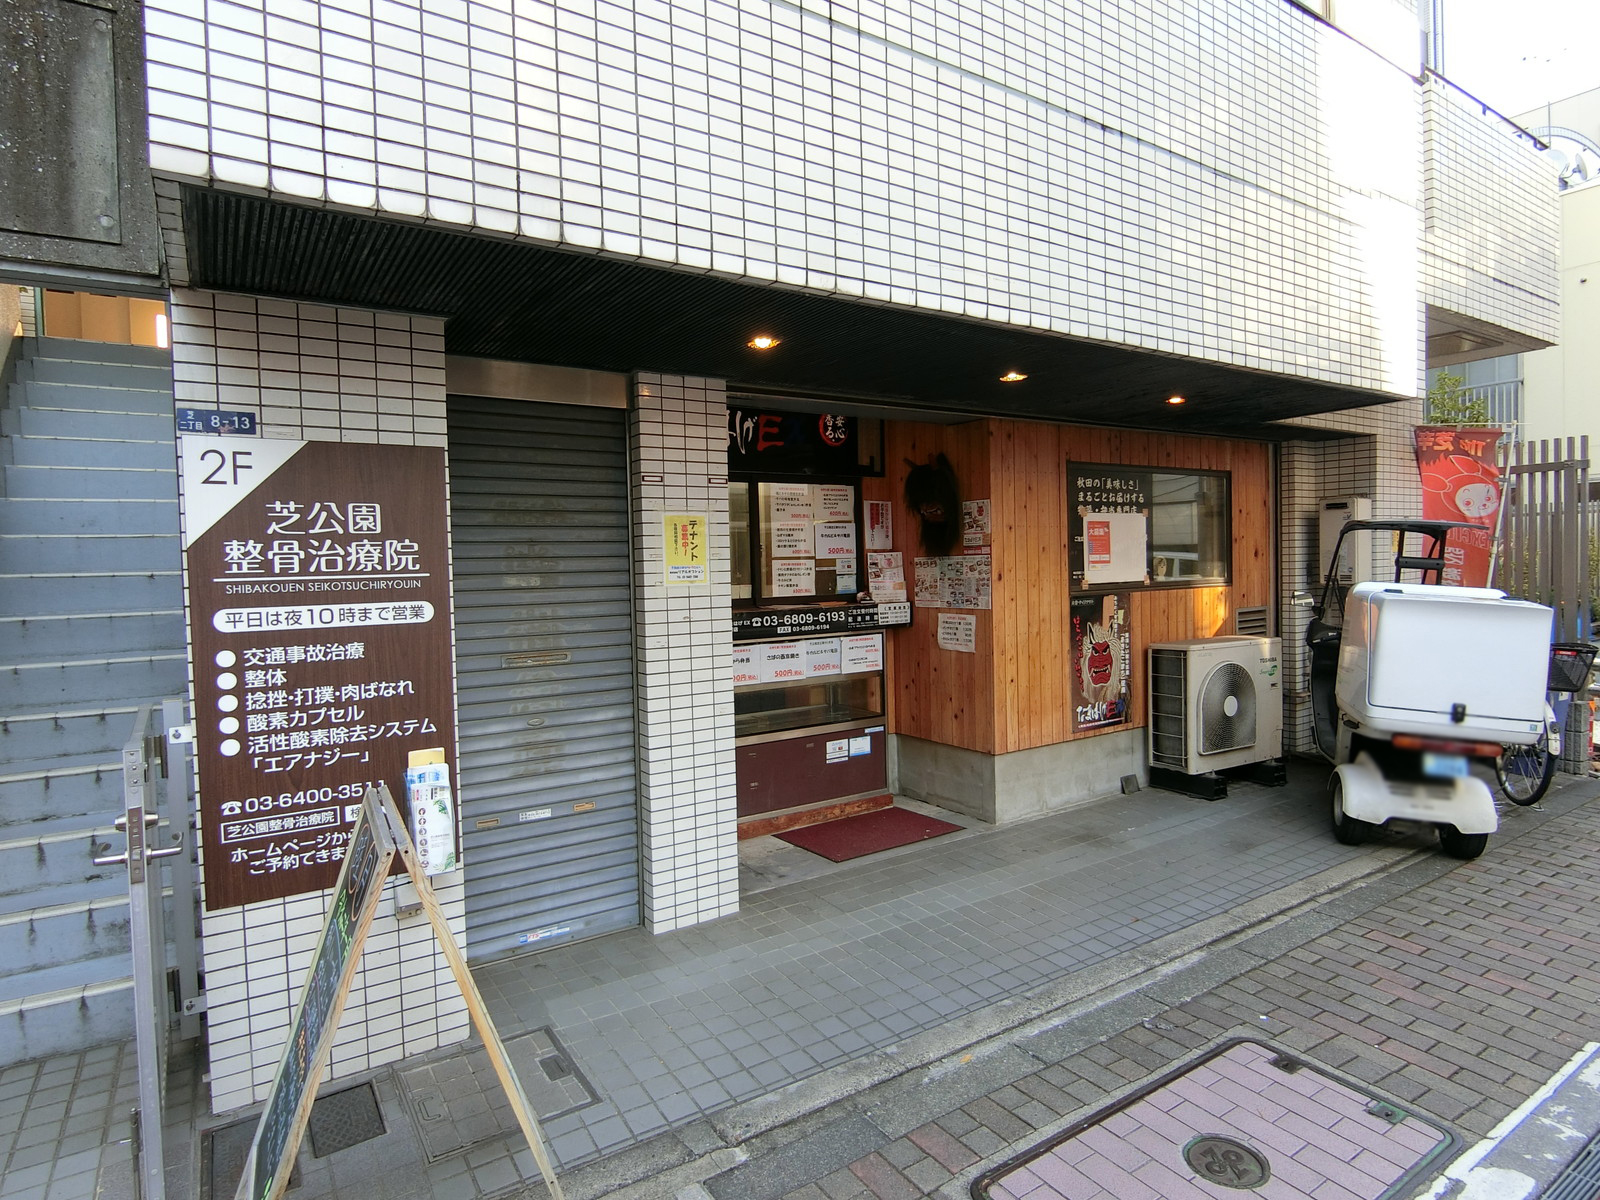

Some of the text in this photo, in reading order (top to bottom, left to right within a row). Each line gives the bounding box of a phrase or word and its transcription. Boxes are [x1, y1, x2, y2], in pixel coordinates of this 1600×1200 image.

[179, 420, 203, 431] 二丁目
[186, 410, 195, 420] 芝
[210, 415, 250, 429] 8-13
[200, 449, 253, 485] 2F
[1076, 476, 1139, 491] 秋田の「美味しさ」
[1077, 491, 1145, 504] まるごとお届けする
[265, 501, 382, 535] 芝公園
[689, 520, 698, 561] テナント
[223, 539, 421, 575] 整骨治療院
[225, 580, 421, 595] SHIBAKOUEN SEIKOTSUCHIRYOUIN
[763, 611, 845, 627] 03-6809-6193
[243, 641, 365, 666] 交通事故治療
[244, 669, 287, 688] 整体
[247, 705, 366, 733] 酸素カプセル
[248, 718, 437, 754] 活性酸素除去システム
[253, 751, 369, 773] 「エアナジー」
[227, 809, 335, 838] 芝公園整骨治療院
[249, 846, 348, 875] ご予約できま
